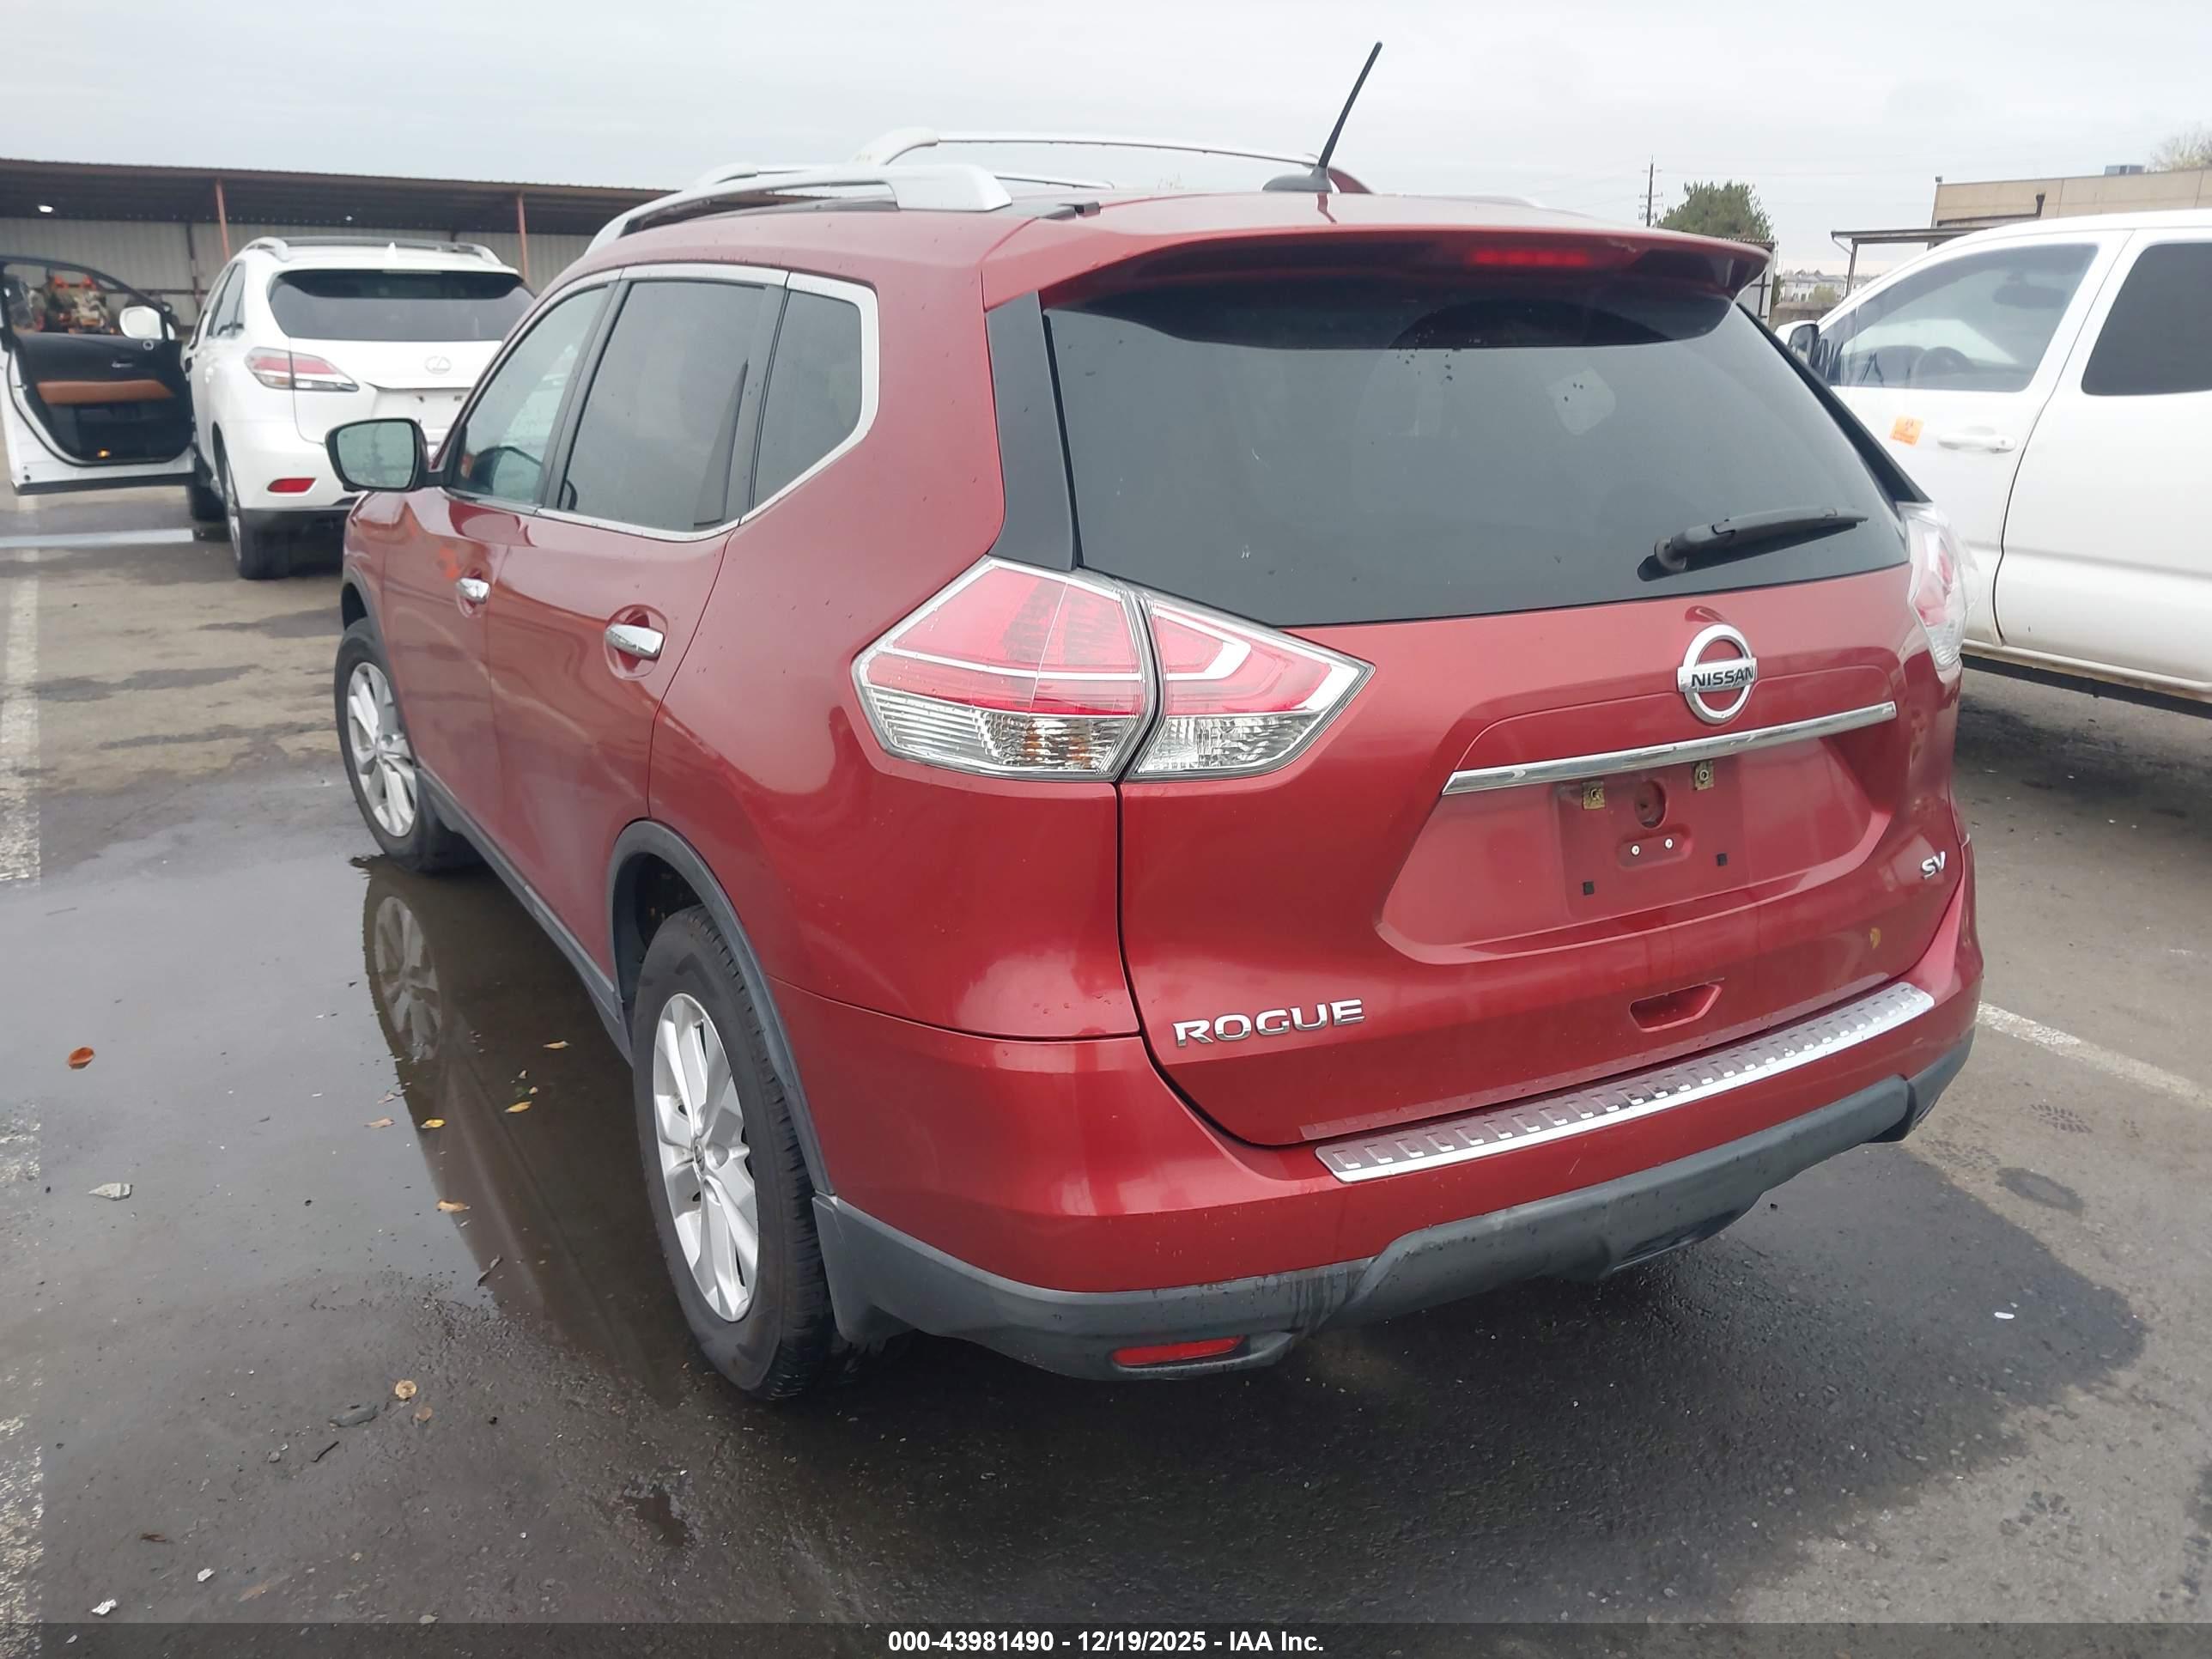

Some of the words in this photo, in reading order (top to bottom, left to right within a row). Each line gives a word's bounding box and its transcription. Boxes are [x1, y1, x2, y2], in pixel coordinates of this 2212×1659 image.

[1691, 665, 1754, 688] NISSAN
[1921, 850, 1947, 880] SV
[1172, 998, 1366, 1048] ROGUE
